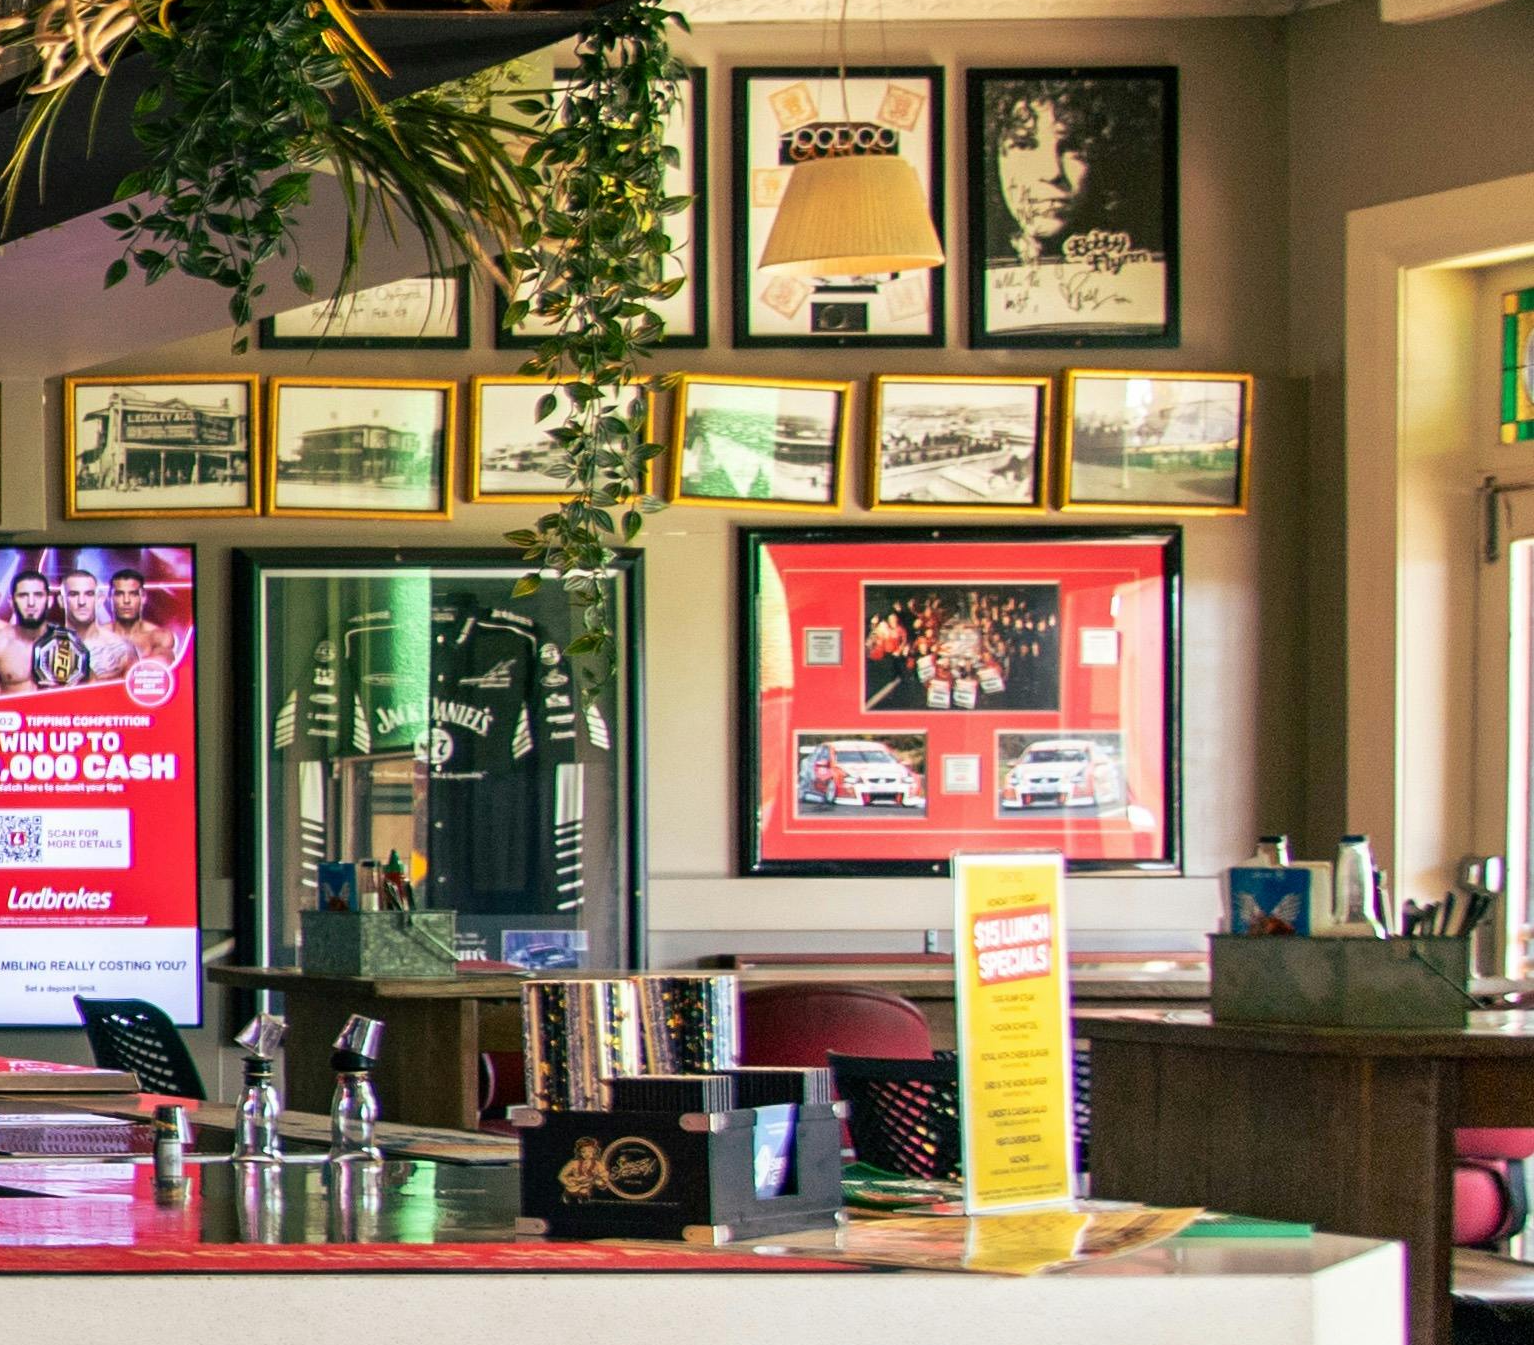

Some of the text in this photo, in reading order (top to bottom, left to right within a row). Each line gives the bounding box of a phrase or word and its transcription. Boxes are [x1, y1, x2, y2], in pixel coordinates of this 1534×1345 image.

[25, 715, 71, 728] TIPPING
[72, 715, 152, 728] COMPETITION
[49, 732, 85, 753] UP
[86, 732, 121, 753] TO
[83, 753, 178, 780] CASH
[47, 830, 99, 838] SCAN FOR
[47, 840, 123, 849] MORE DETAILS
[7, 886, 113, 910] Ladbrokes
[1000, 912, 1051, 948] LUNCH
[50, 960, 95, 972] REALLY
[98, 960, 152, 972] COSTING
[155, 960, 188, 972] YOU?
[978, 944, 1051, 982] SPECIALS
